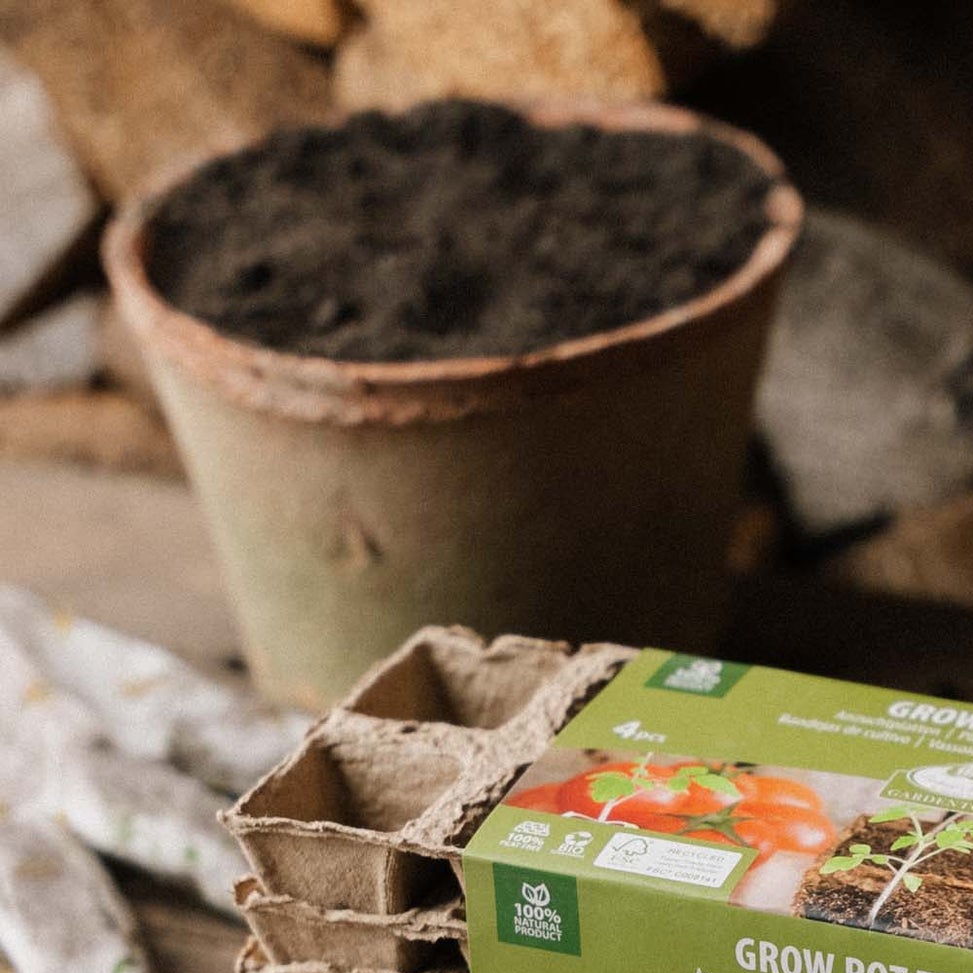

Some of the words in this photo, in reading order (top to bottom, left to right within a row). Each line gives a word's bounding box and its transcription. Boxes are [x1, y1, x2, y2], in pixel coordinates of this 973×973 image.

[611, 720, 641, 740] 4
[514, 902, 562, 924] 100%
[514, 916, 562, 933] NATURAL
[515, 925, 562, 941] PRODUCT
